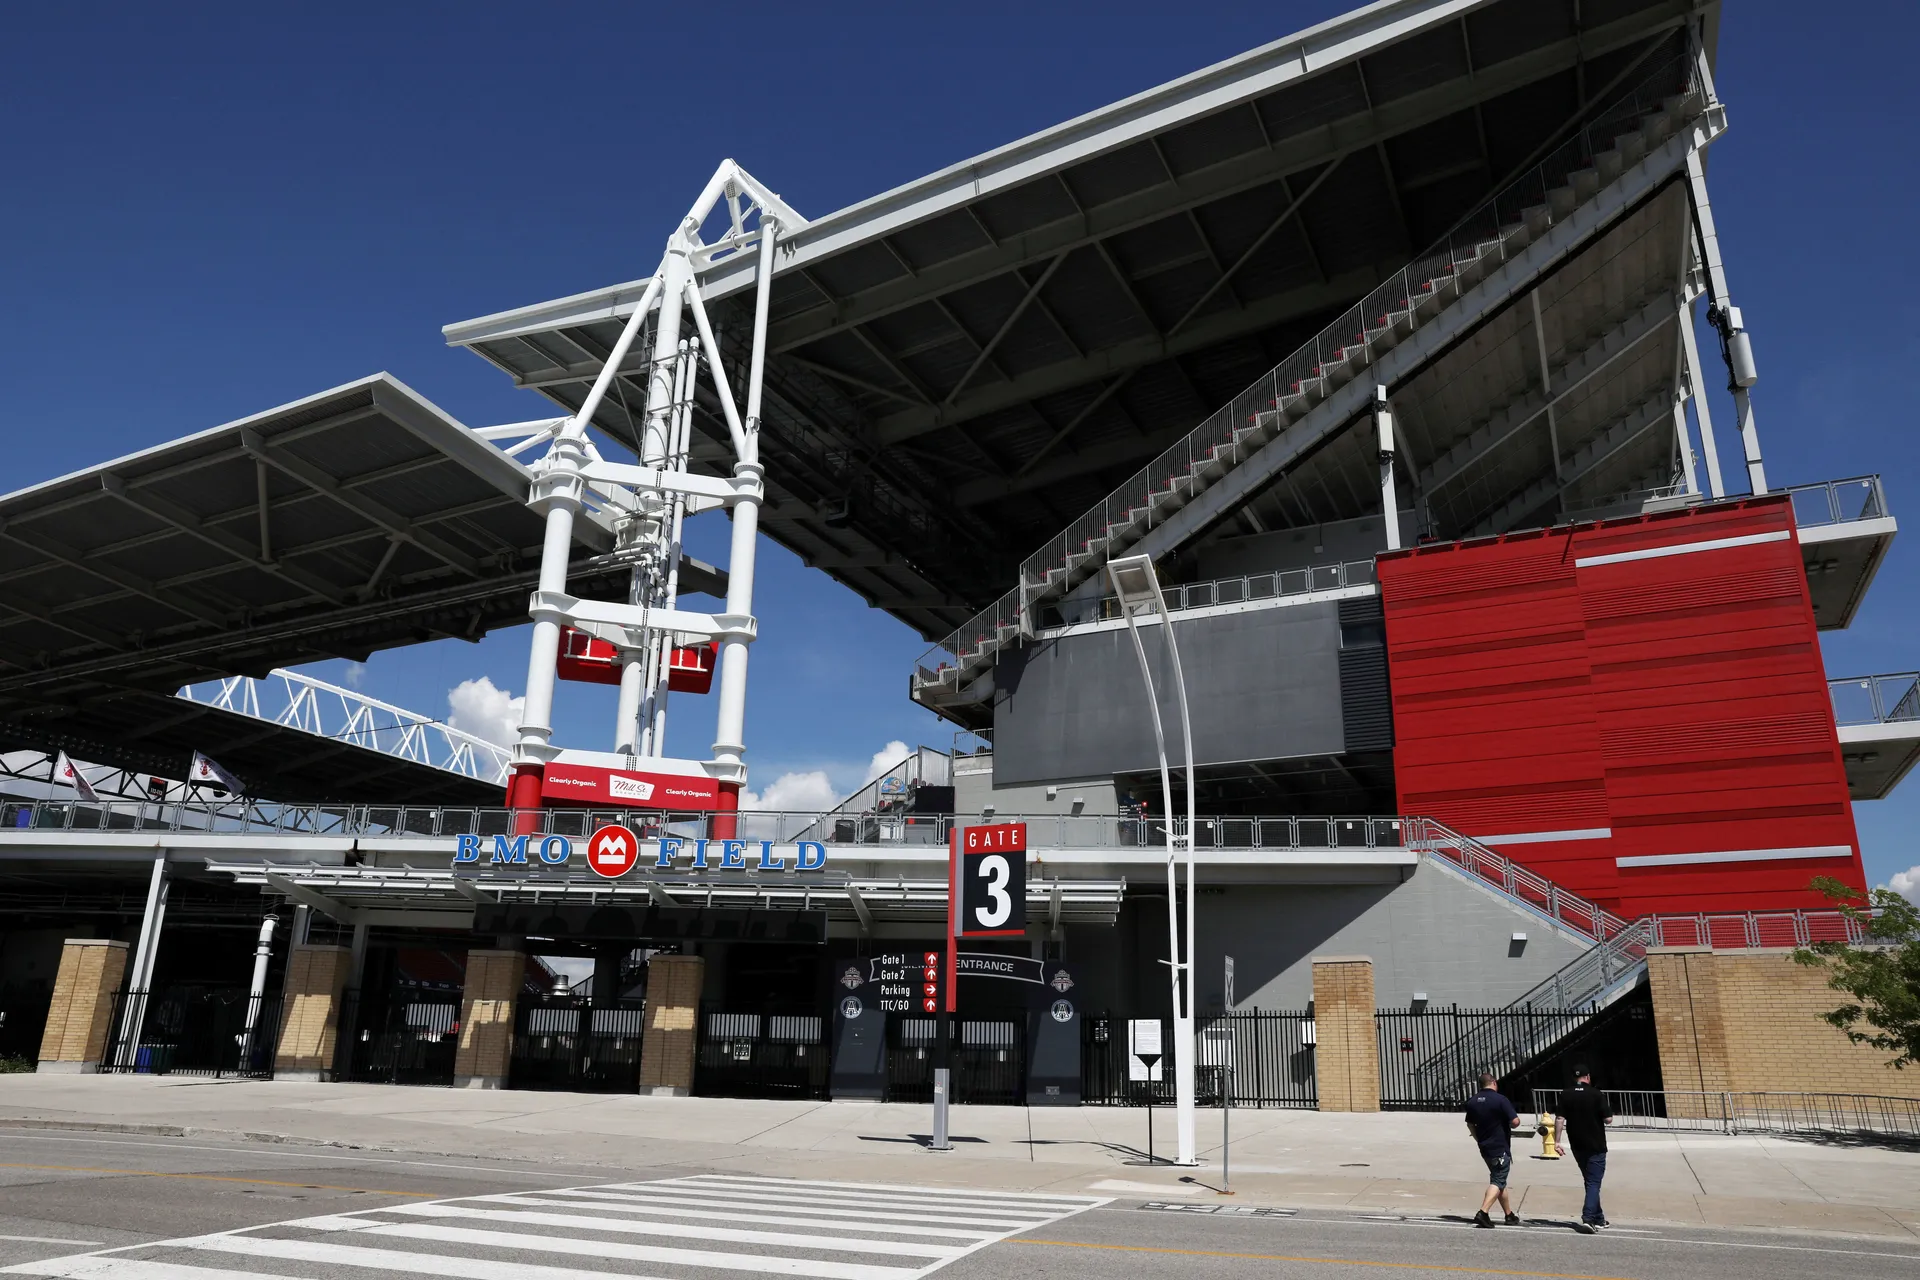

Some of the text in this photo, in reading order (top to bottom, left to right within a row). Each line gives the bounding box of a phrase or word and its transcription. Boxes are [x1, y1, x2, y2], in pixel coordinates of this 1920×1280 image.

[549, 776, 597, 787] Clearly Organic
[614, 779, 636, 792] Mill
[665, 788, 712, 798] Clearly Organic
[968, 829, 1018, 848] GATE
[452, 833, 829, 871] BMO FIELD
[975, 854, 1012, 928] 3
[882, 954, 899, 964] Gate
[956, 959, 1015, 973] ENTRANCE
[881, 969, 905, 980] Gate 2
[881, 984, 910, 997] Parking
[880, 1000, 909, 1012] TTC/GO
